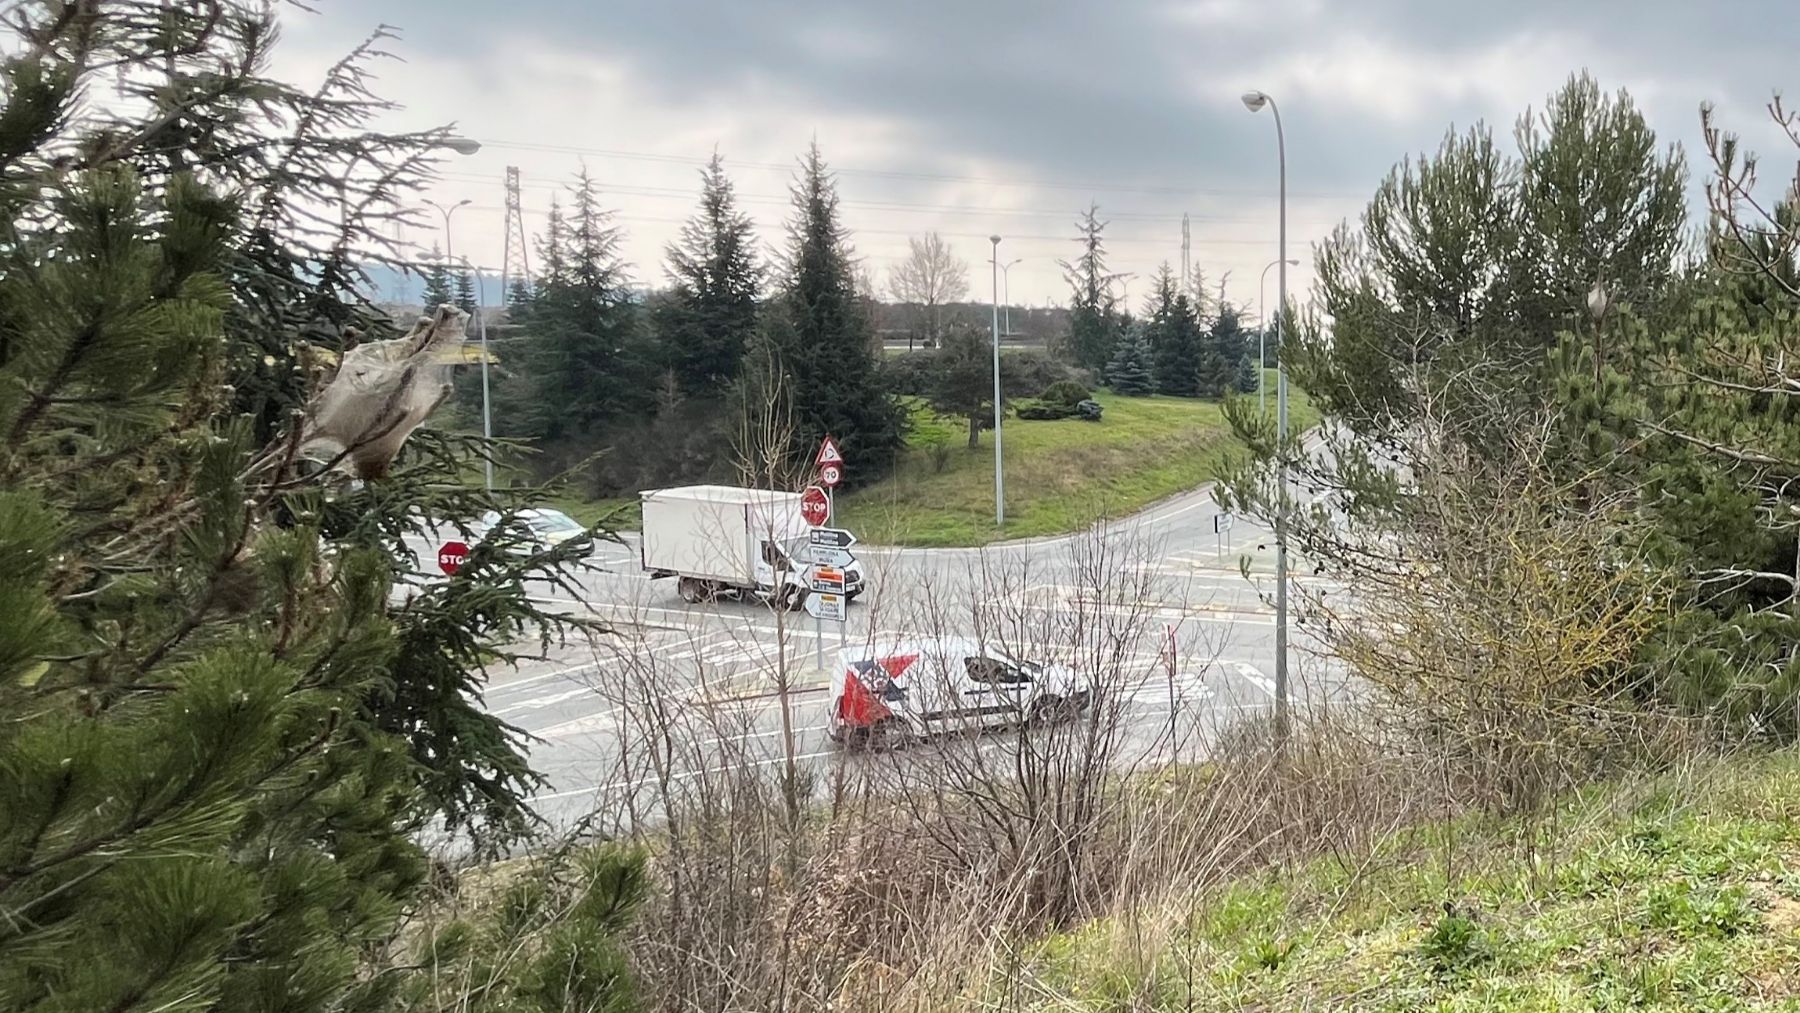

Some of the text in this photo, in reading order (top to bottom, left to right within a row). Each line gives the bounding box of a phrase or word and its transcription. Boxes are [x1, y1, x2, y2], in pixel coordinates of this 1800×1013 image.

[825, 470, 837, 479] 70
[802, 501, 826, 512] STOP
[440, 554, 466, 565] STO
